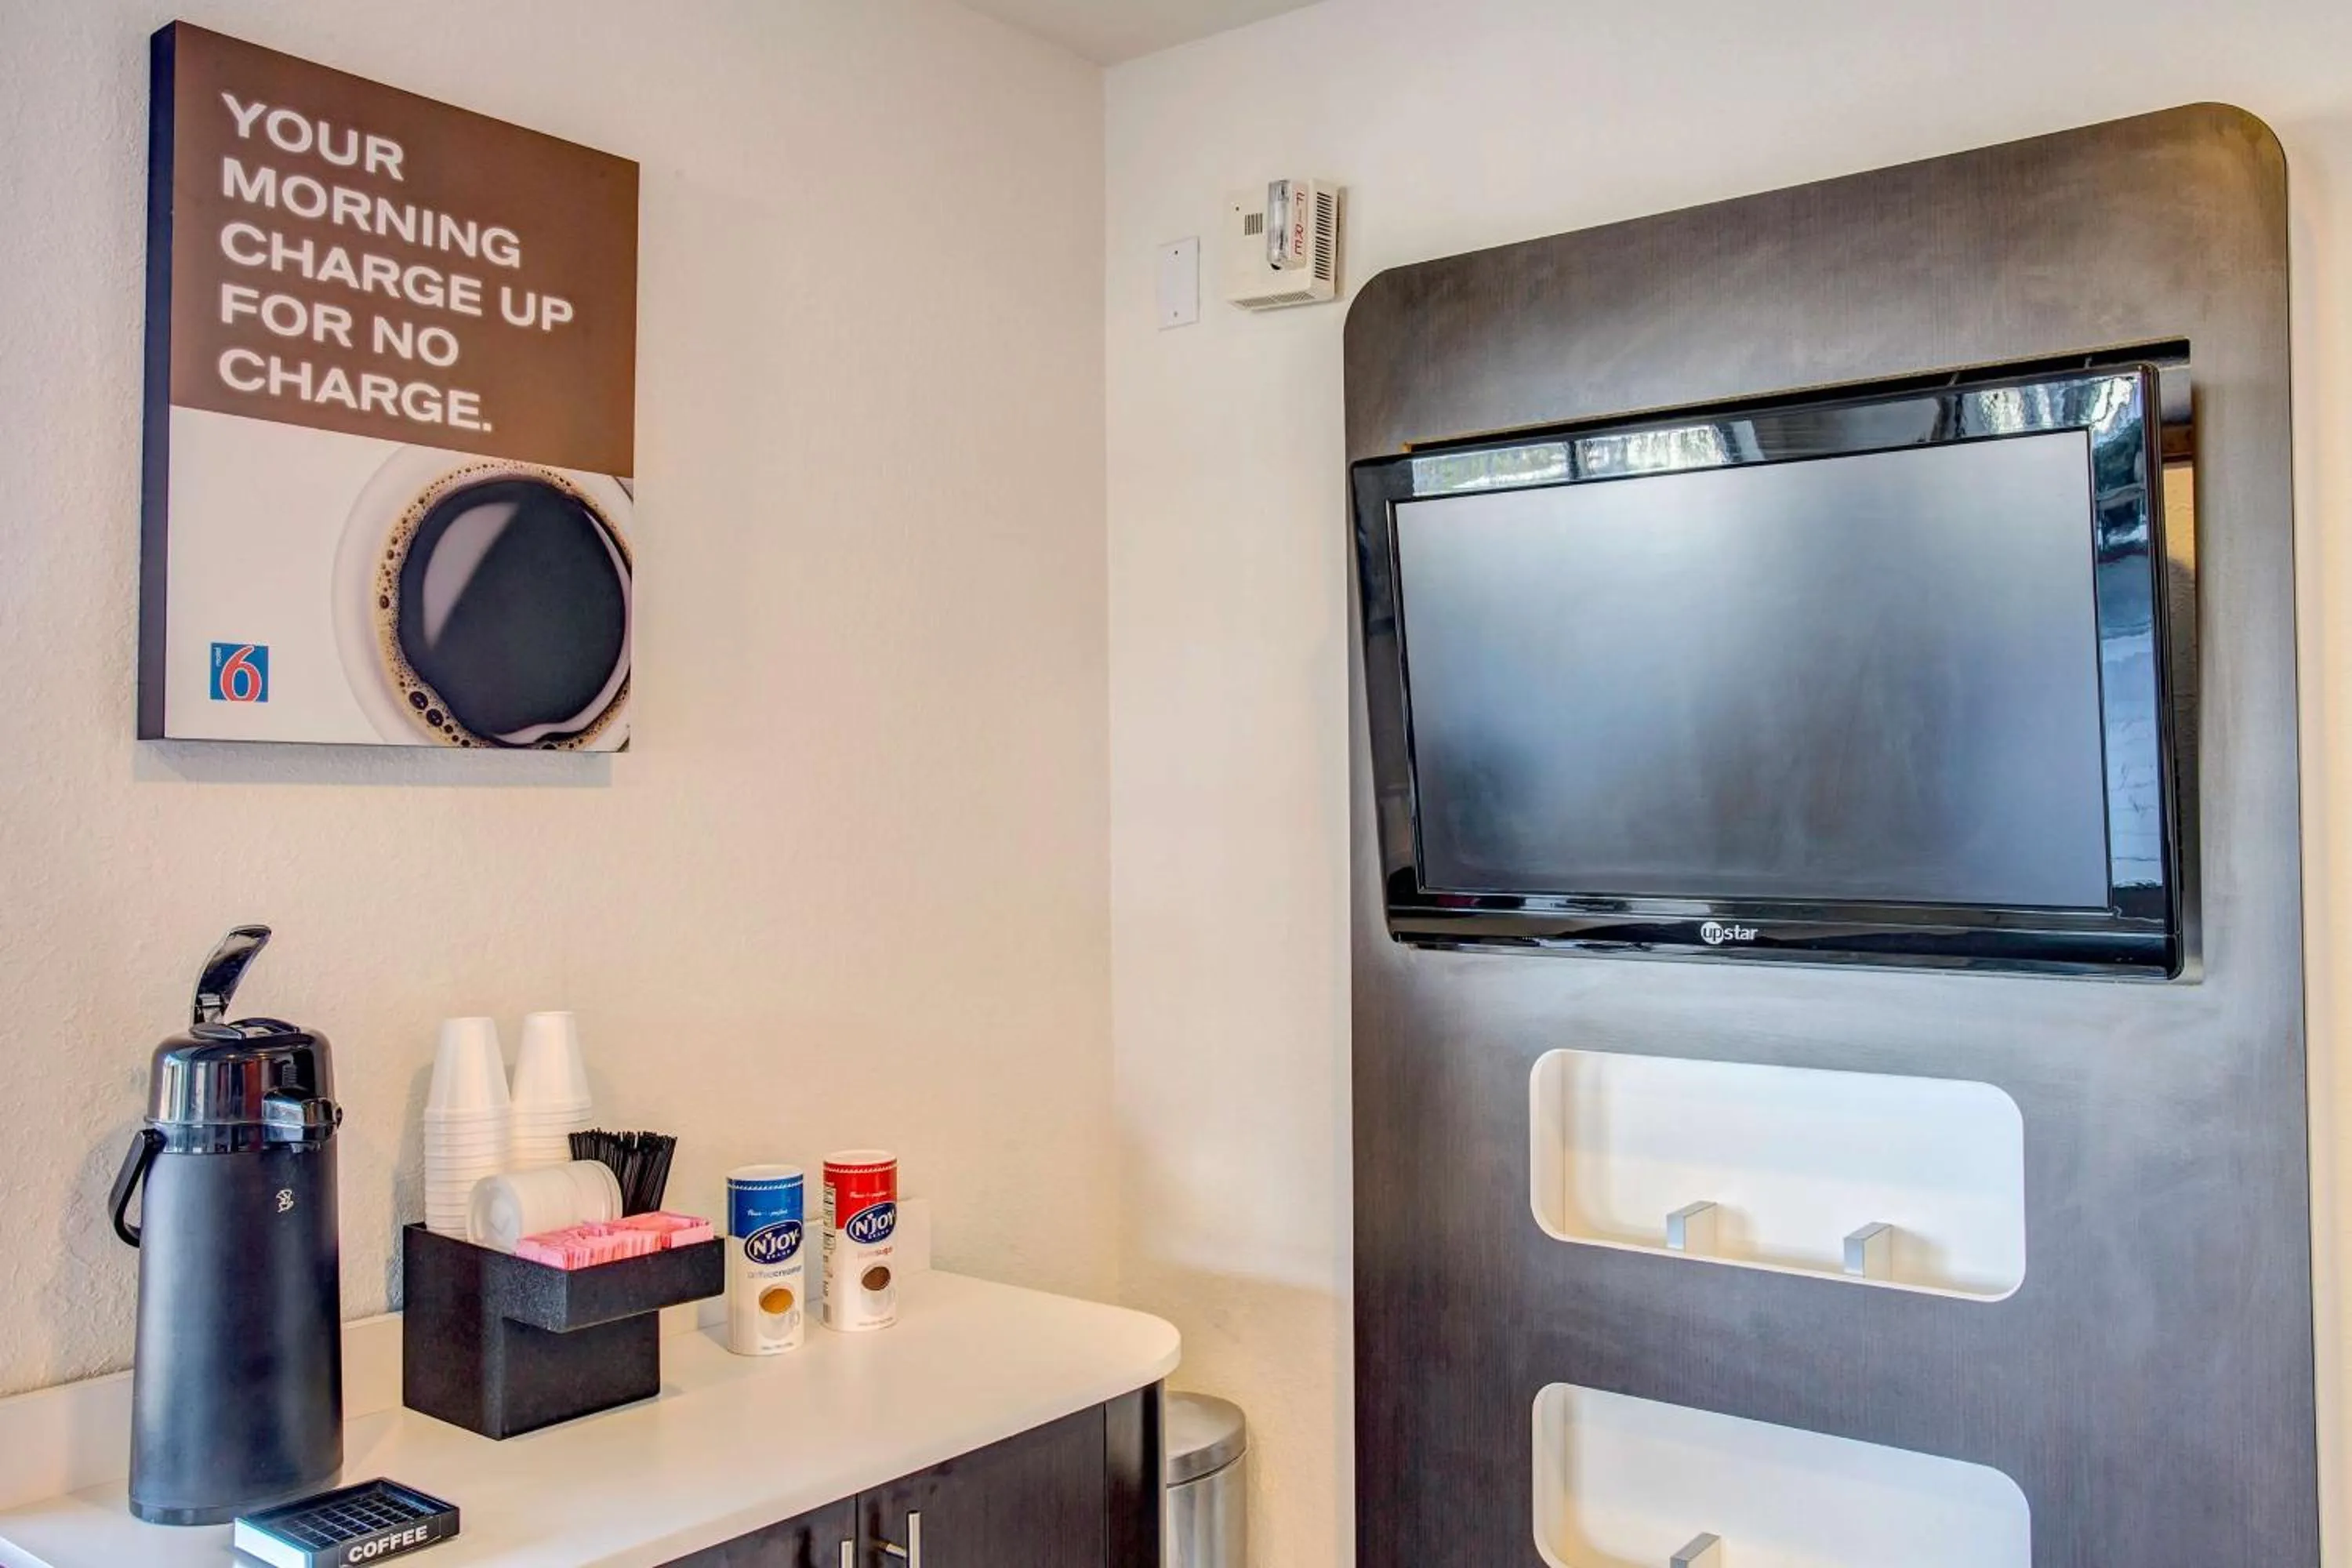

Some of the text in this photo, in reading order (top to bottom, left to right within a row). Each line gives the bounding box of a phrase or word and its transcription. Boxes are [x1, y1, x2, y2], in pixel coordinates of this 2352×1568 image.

[221, 93, 405, 181] YOUR
[223, 157, 521, 268] MORNING
[220, 222, 574, 332] CHARGE UP
[221, 283, 459, 368] FOR NO
[218, 349, 493, 433] CHARGE.
[220, 644, 263, 702] 6
[1700, 922, 1759, 944] upstar
[348, 1525, 428, 1563] COFFEE
